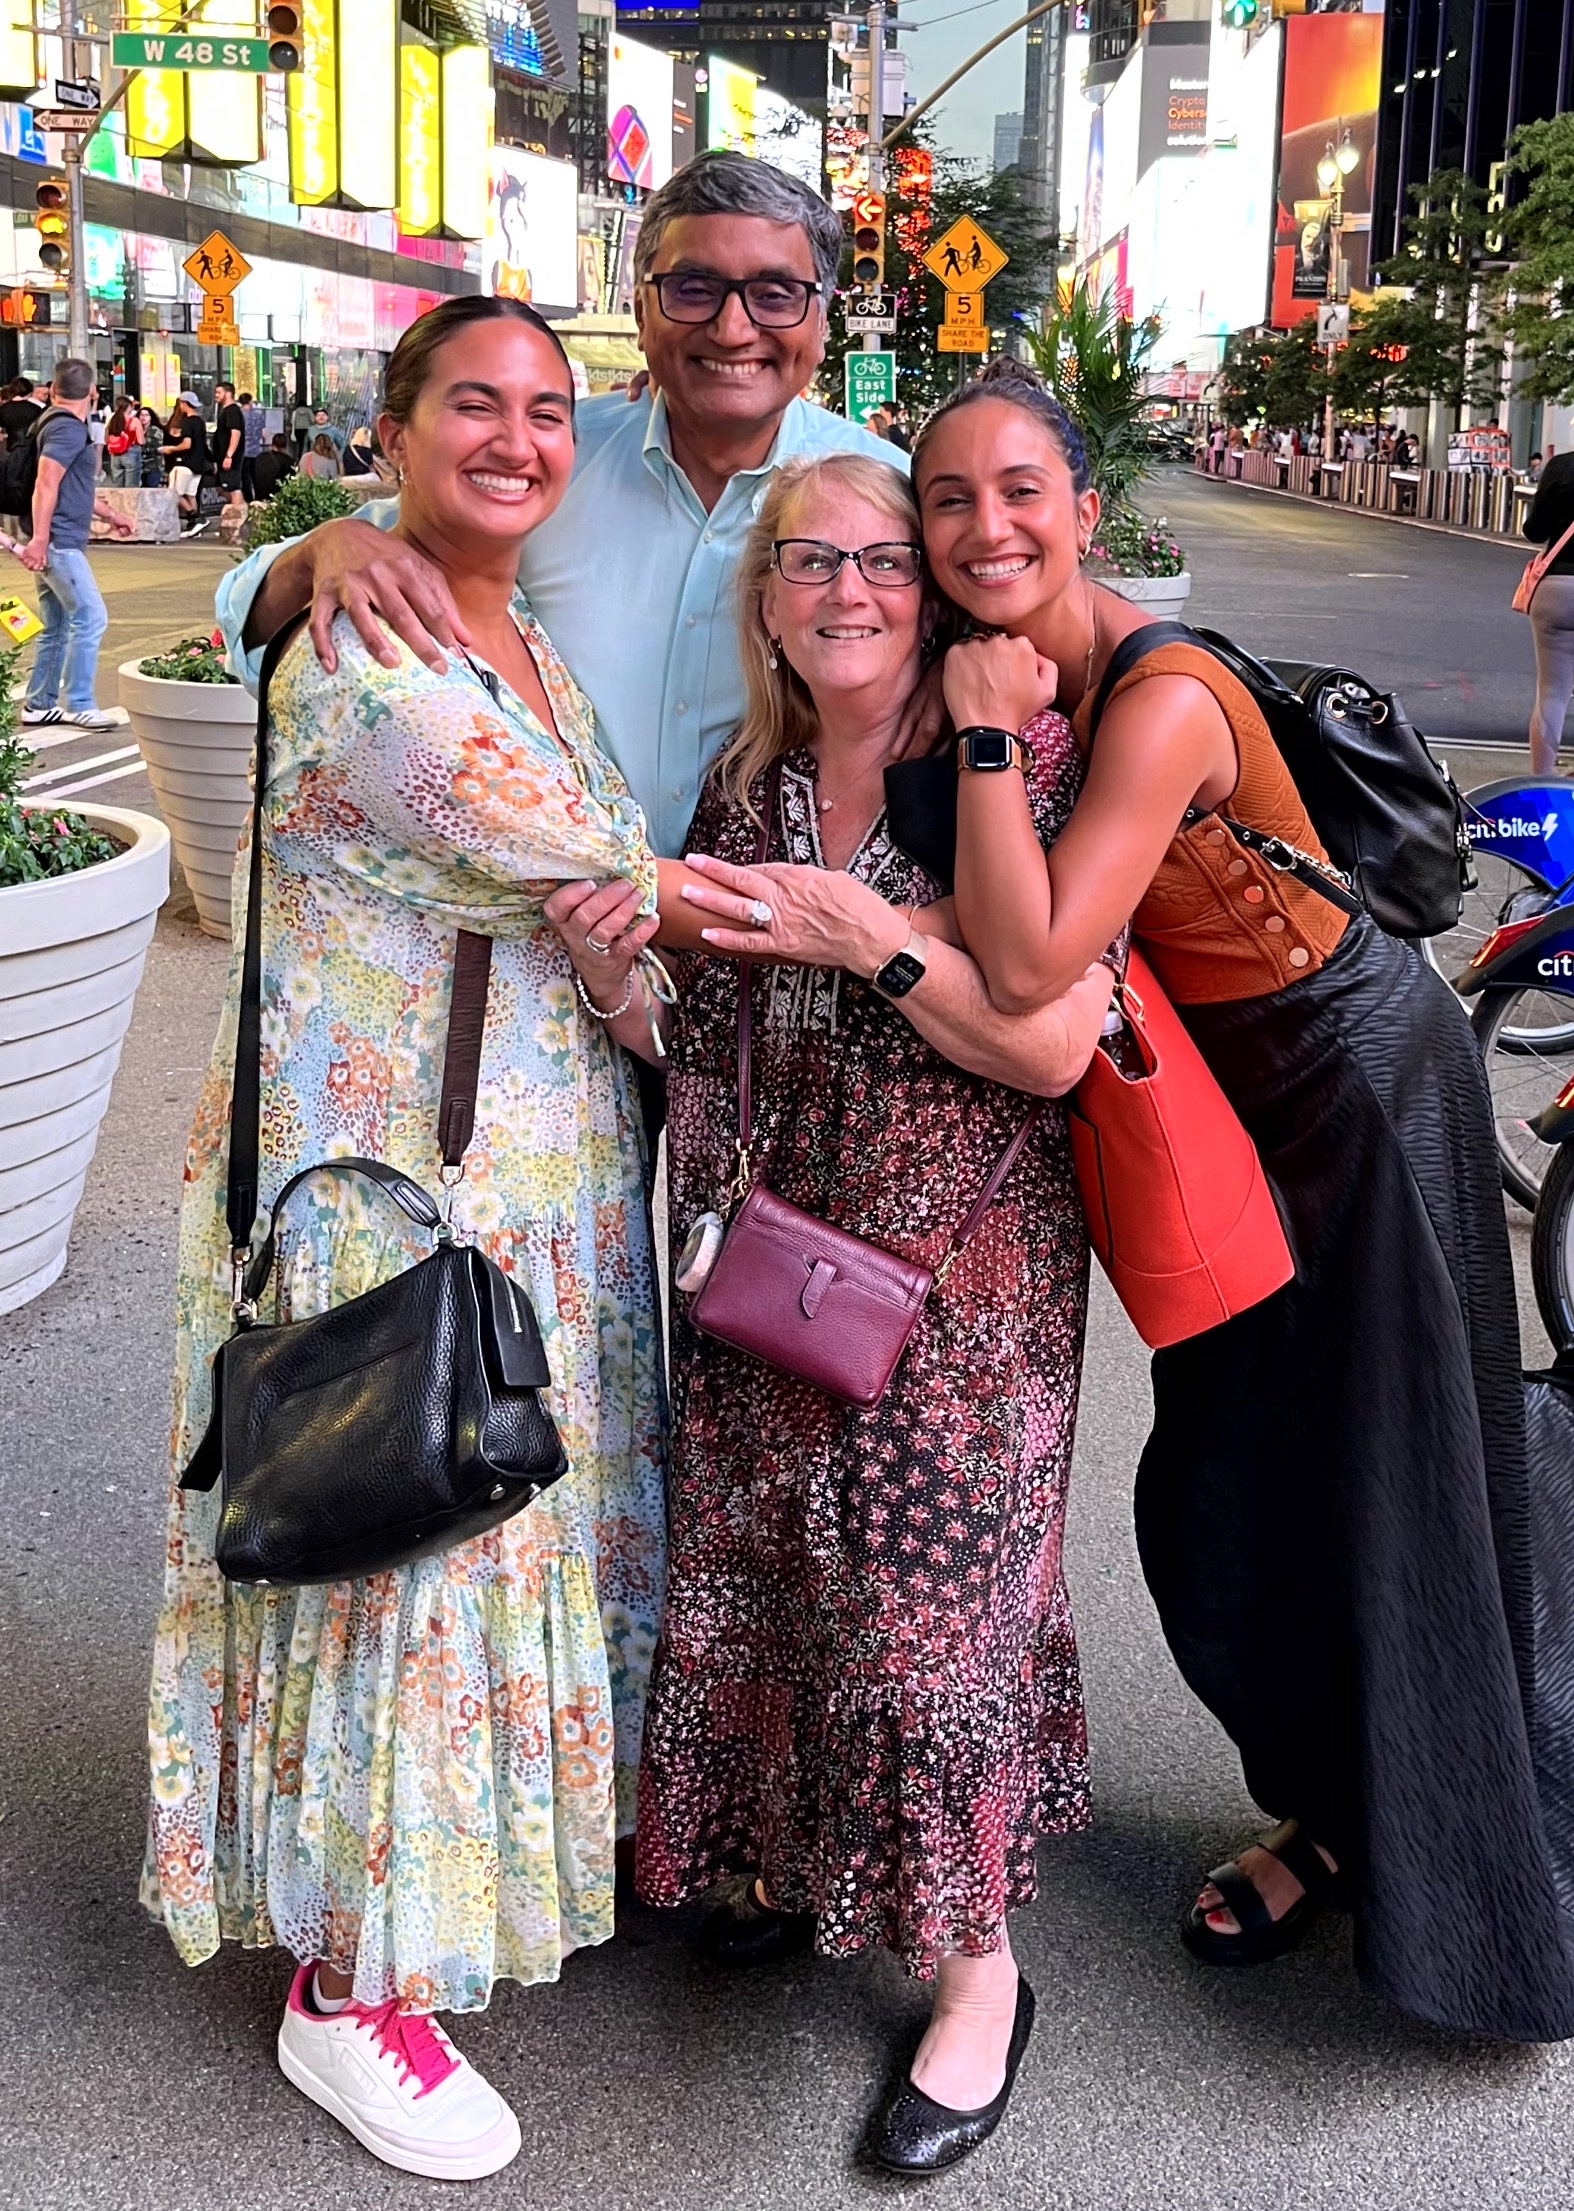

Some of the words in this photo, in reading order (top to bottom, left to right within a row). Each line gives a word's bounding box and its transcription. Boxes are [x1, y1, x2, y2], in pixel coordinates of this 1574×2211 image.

[143, 40, 165, 62] W
[175, 42, 213, 64] 48
[222, 44, 251, 66] St
[1168, 96, 1205, 107] Crypto
[1168, 107, 1208, 120] Cybers
[41, 115, 61, 126] ONE
[72, 116, 94, 127] WAY
[213, 298, 225, 314] 5
[957, 296, 971, 314] 5
[871, 321, 892, 329] LANE
[942, 329, 967, 337] SHARE
[971, 330, 985, 338] THE
[1322, 332, 1344, 340] ONLY
[952, 339, 974, 347] ROAD
[855, 380, 886, 391] East
[855, 392, 886, 403] Side
[1498, 817, 1541, 838] bike
[1537, 954, 1574, 976] cit
